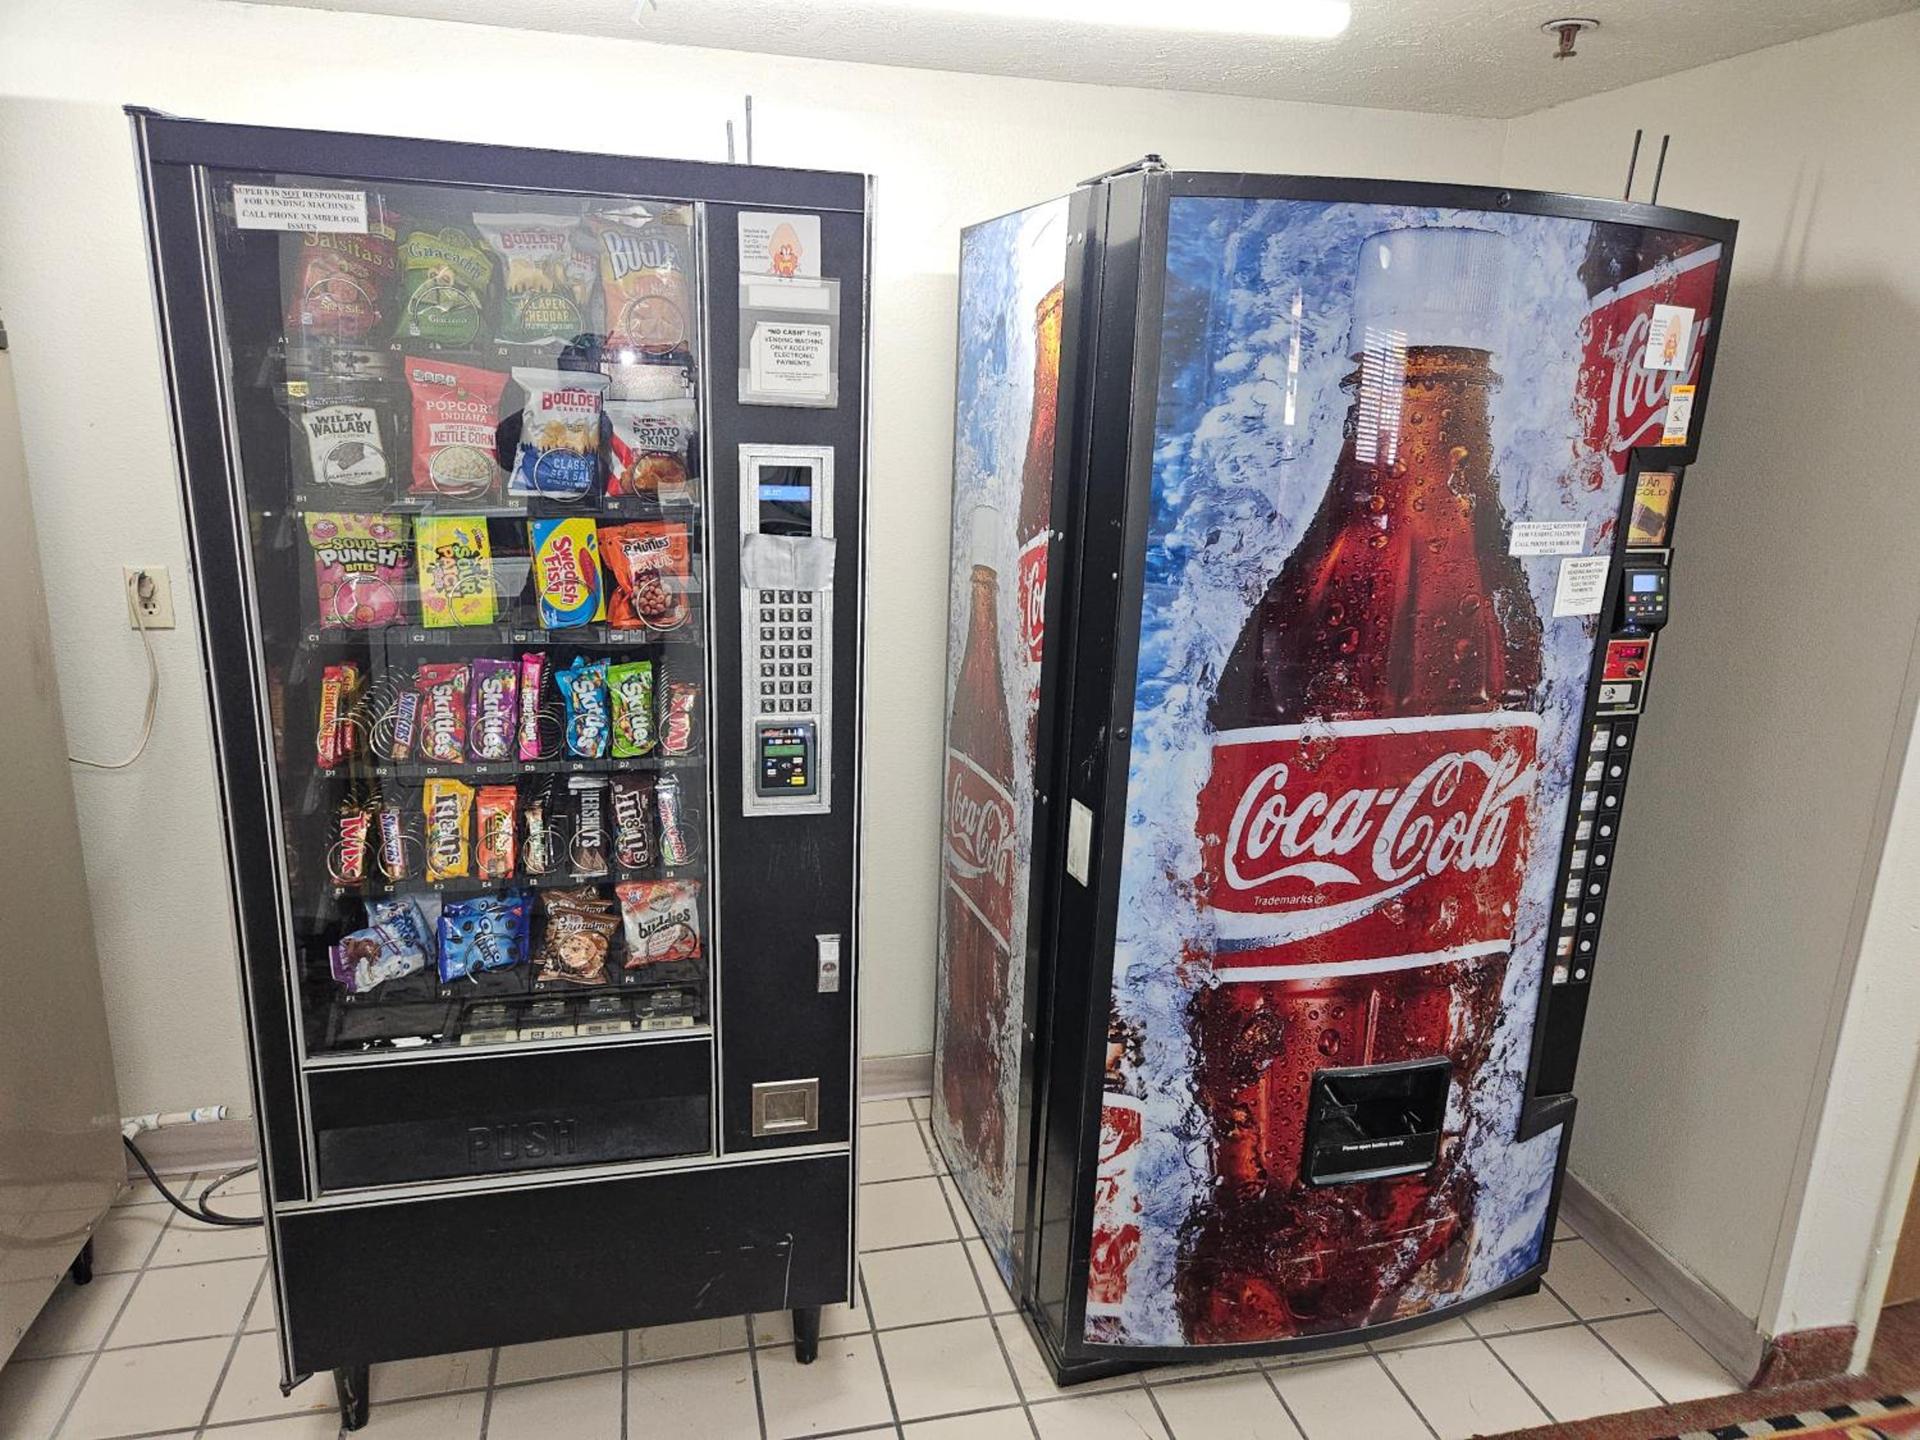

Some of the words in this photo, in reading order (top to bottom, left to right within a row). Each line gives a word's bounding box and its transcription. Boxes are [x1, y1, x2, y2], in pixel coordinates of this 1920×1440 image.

[244, 198, 262, 206] FOR
[264, 199, 305, 208] VENDING
[308, 202, 355, 210] MACHINES
[282, 190, 300, 199] NOT
[242, 210, 266, 219] CALL
[268, 212, 299, 220] PHONE
[301, 214, 339, 222] NUMBER
[500, 230, 566, 252] BOULDER
[541, 390, 601, 414] BOULDER
[316, 412, 363, 425] WILEY
[440, 413, 487, 423] INDIANA
[310, 421, 373, 438] WALLABY
[434, 430, 467, 444] KETTLE
[468, 431, 494, 446] CORN
[632, 426, 679, 438] POTATO
[639, 434, 677, 448] SKINS
[331, 538, 378, 550] SOUR
[318, 547, 398, 567] PUNCH
[345, 563, 375, 573] BITES
[543, 553, 562, 593] Fish
[552, 534, 579, 605] Swedish
[395, 692, 417, 744] SNICKERS
[432, 684, 455, 757] Skittles
[481, 677, 505, 760] Skittles
[571, 677, 606, 755] Skittles
[1224, 748, 1538, 890] Coca-Cola
[951, 773, 1014, 888] Coca-Cola
[340, 811, 366, 878] TWIX
[638, 907, 692, 939] buddies
[467, 1118, 577, 1166] PUSH
